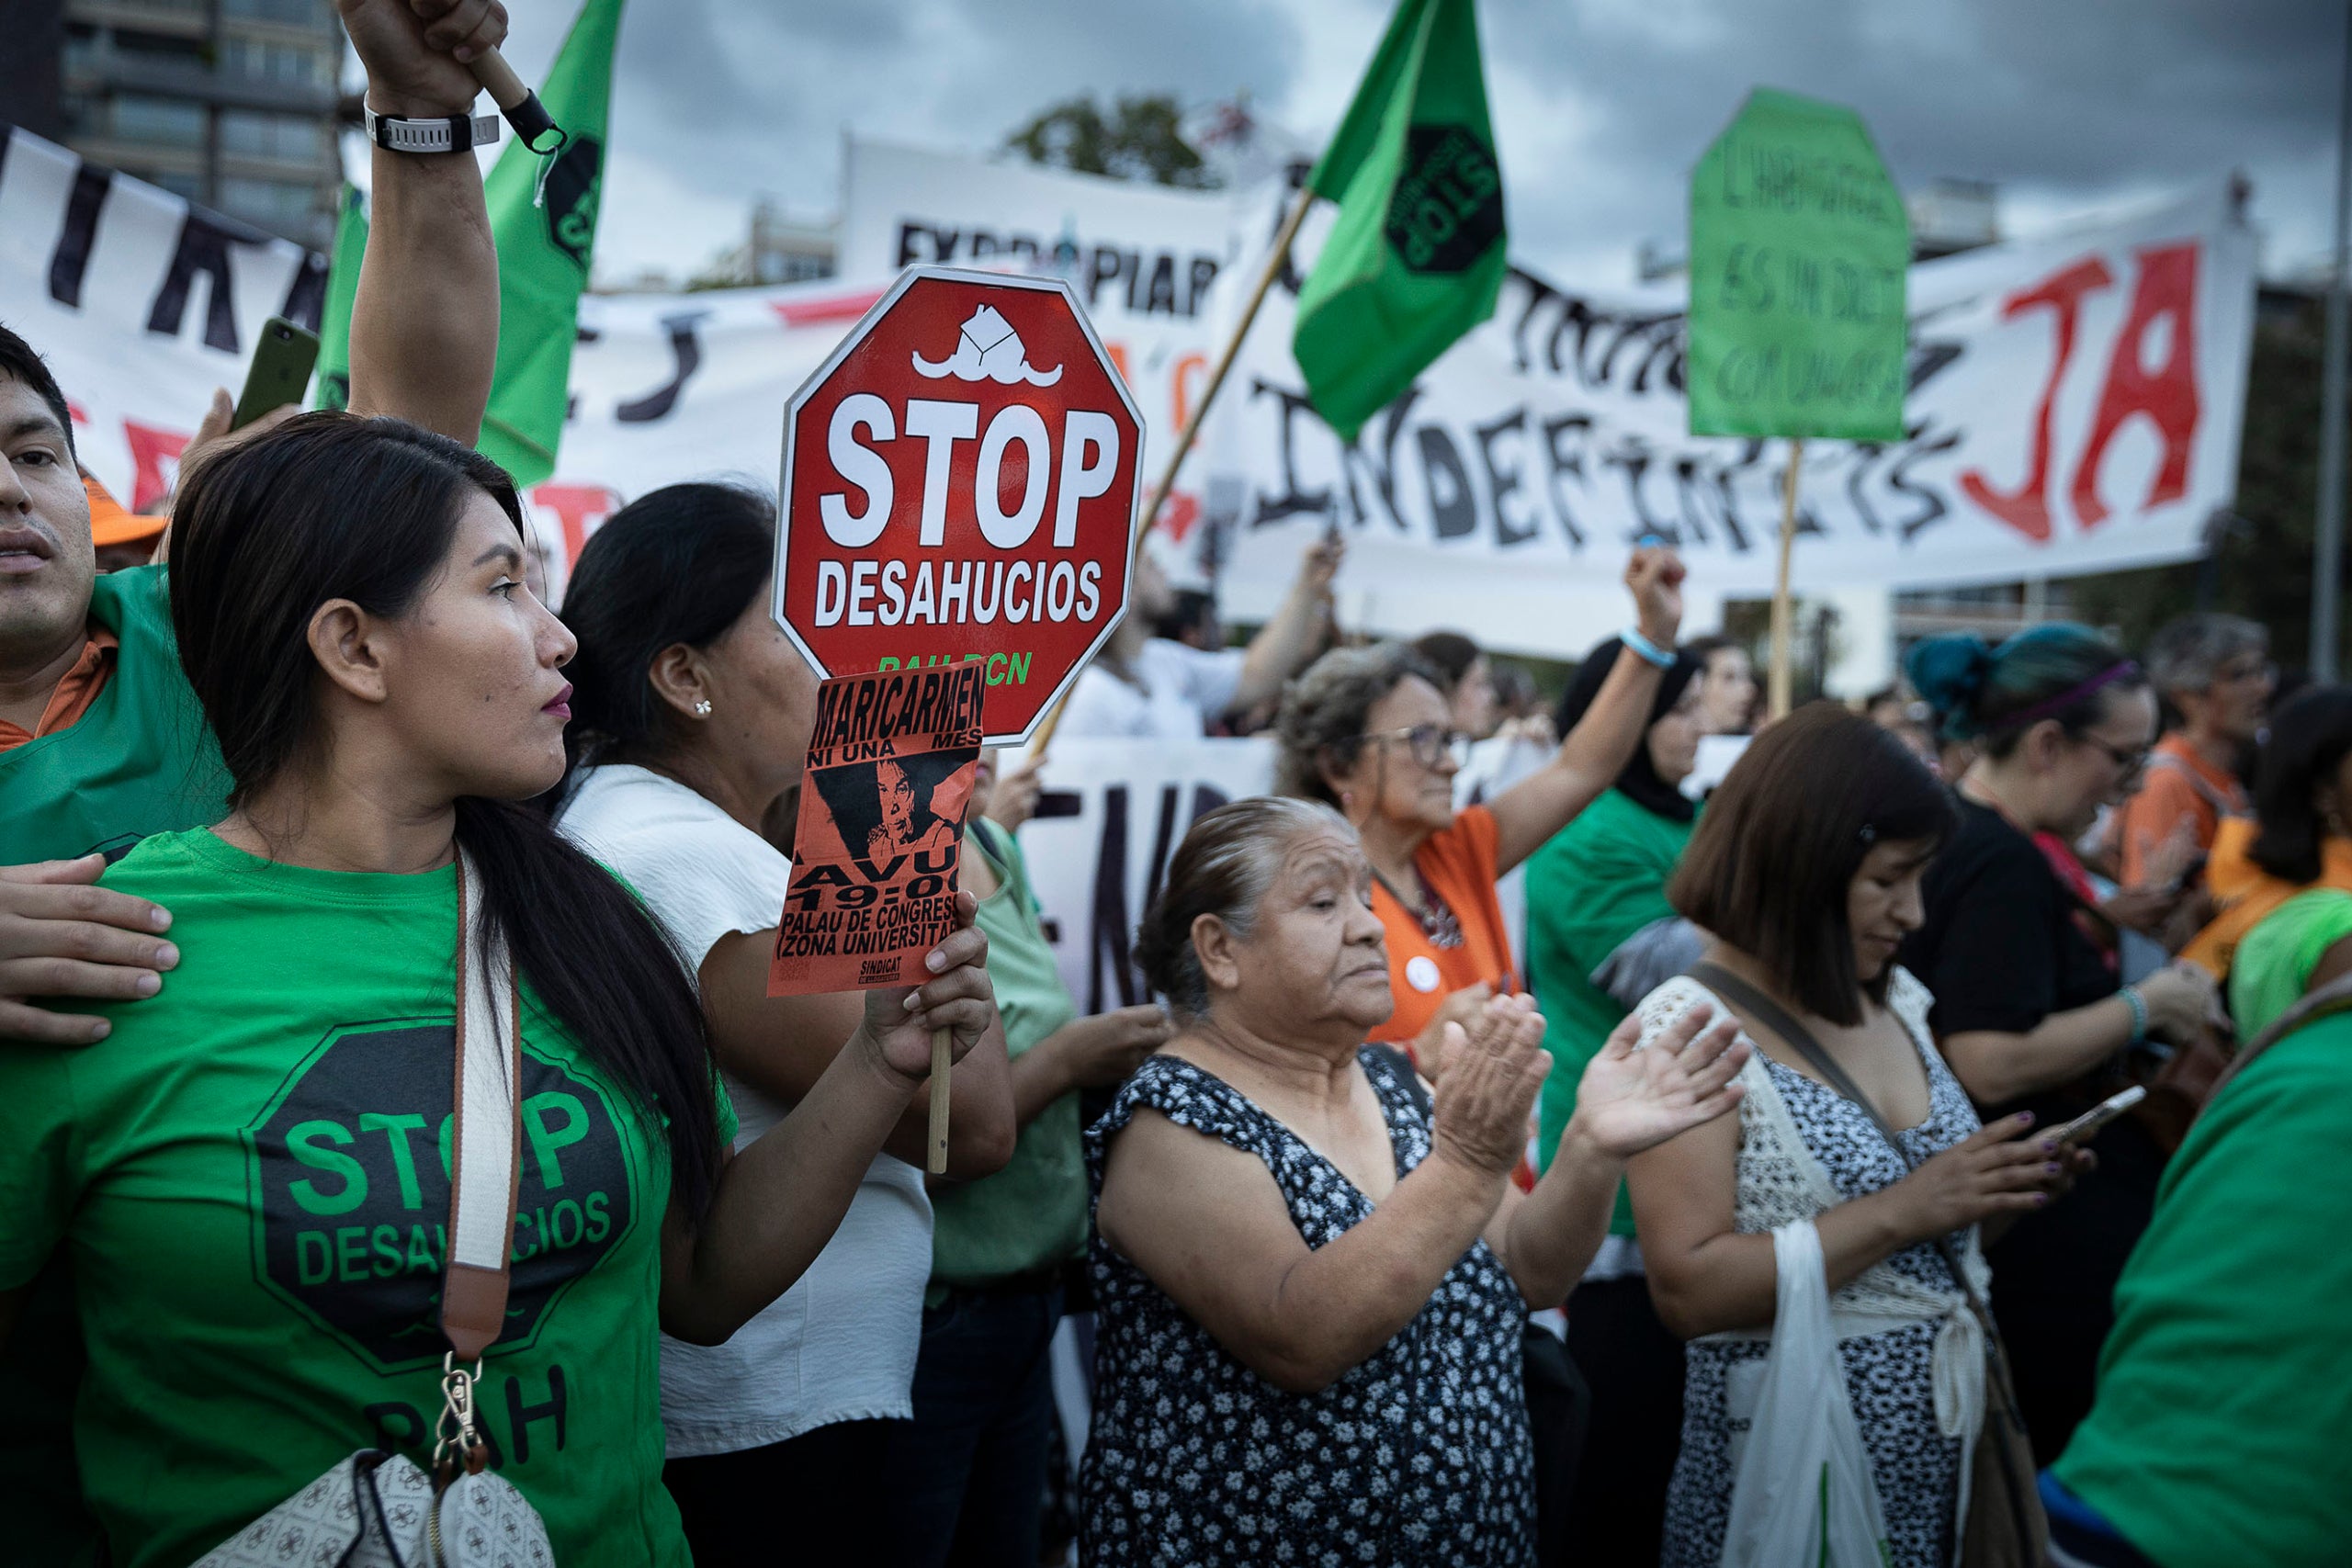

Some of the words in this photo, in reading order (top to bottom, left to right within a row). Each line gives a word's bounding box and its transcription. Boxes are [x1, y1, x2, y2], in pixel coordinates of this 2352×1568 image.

[1959, 239, 2200, 545] JA
[820, 392, 1120, 549] STOP
[815, 559, 1102, 628] DESAHUCIOS
[965, 651, 1033, 686] CN
[809, 665, 987, 750] MARICARMEN
[807, 750, 832, 769] NI
[842, 739, 896, 762] UNA
[791, 841, 962, 888] AVU
[782, 911, 842, 934] PALAU
[847, 908, 872, 932] DE
[776, 932, 836, 960] (ZONA
[861, 956, 901, 975] SINDICAT
[296, 1191, 610, 1285] DESACIOS
